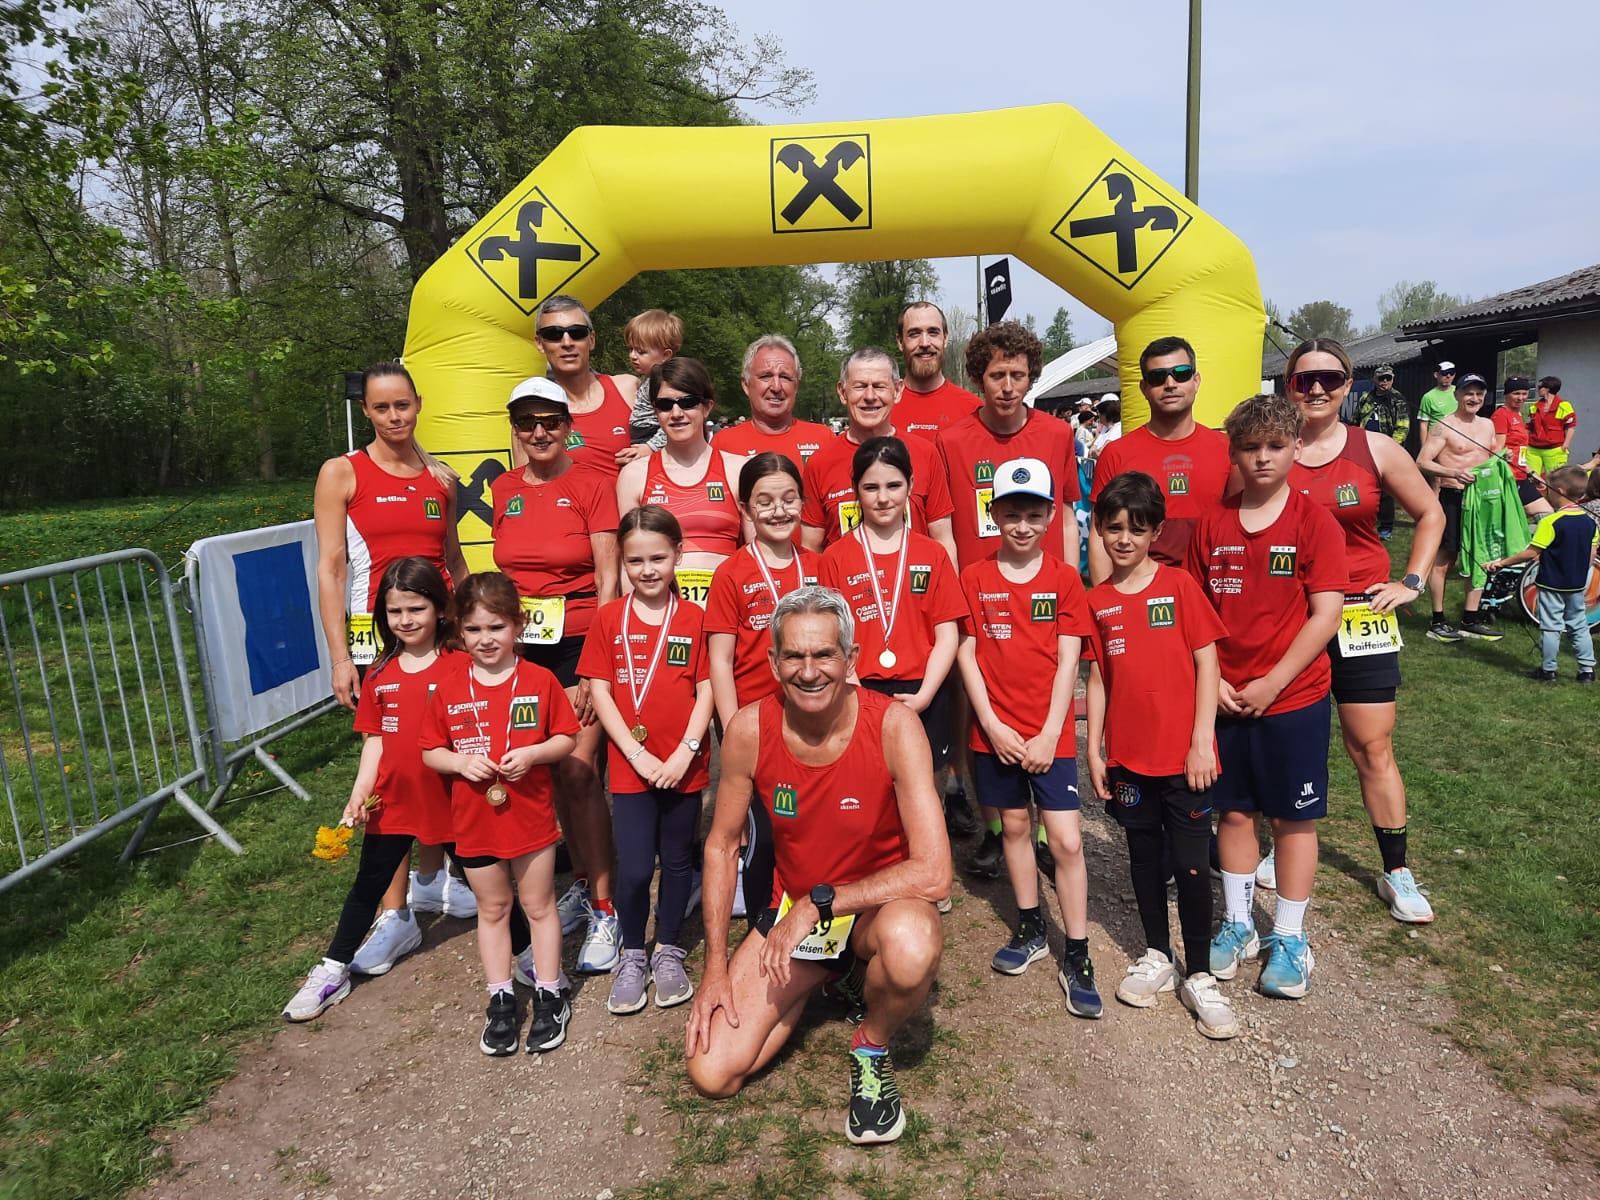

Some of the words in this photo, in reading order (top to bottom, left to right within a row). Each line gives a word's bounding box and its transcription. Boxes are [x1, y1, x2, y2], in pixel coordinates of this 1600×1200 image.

[376, 495, 408, 503] Bettina
[646, 495, 669, 504] ANGELA
[680, 586, 710, 602] 317
[1359, 618, 1390, 637] 310
[348, 630, 373, 646] 341
[1348, 640, 1392, 652] Raiffeisen
[1300, 781, 1315, 796] JK
